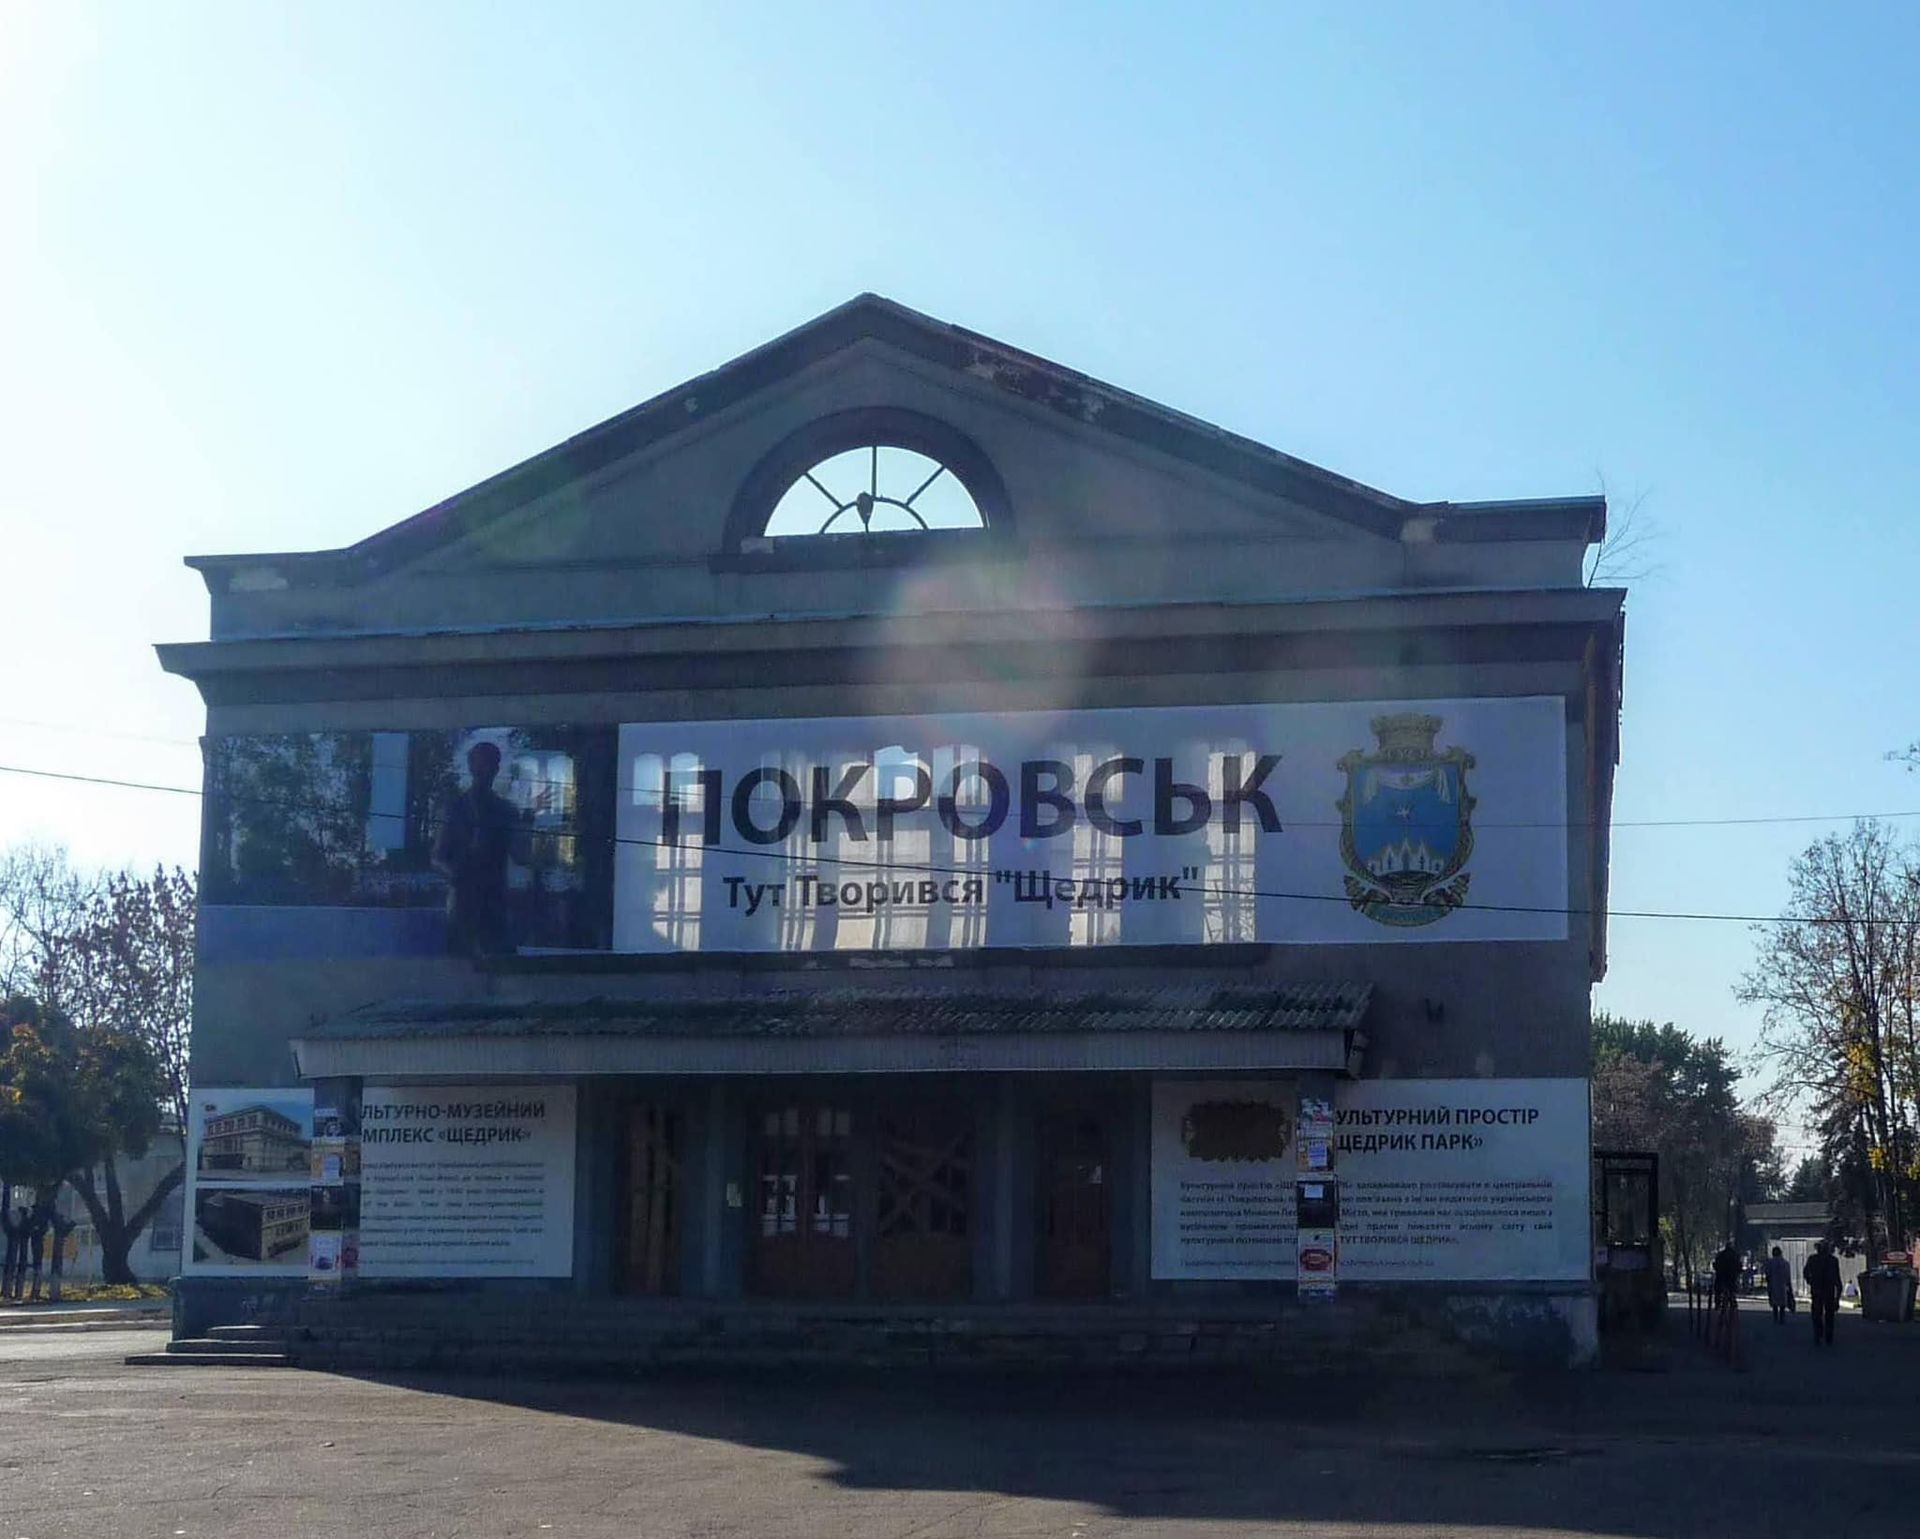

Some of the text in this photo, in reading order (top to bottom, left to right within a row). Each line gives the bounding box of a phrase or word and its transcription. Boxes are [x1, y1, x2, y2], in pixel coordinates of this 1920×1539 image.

[661, 755, 1283, 846] ПОКРОВСЬК
[722, 866, 1199, 917] Тут Творився "Щедрик"
[360, 1100, 545, 1119] ЛЬТУРНО-МУЗЕЙНИЙ
[1336, 1105, 1540, 1126] УЛЬТУРНИЙ ПРОСТІР
[362, 1127, 434, 1144] МПЛЕКС
[1421, 1133, 1484, 1151] ПАРК»
